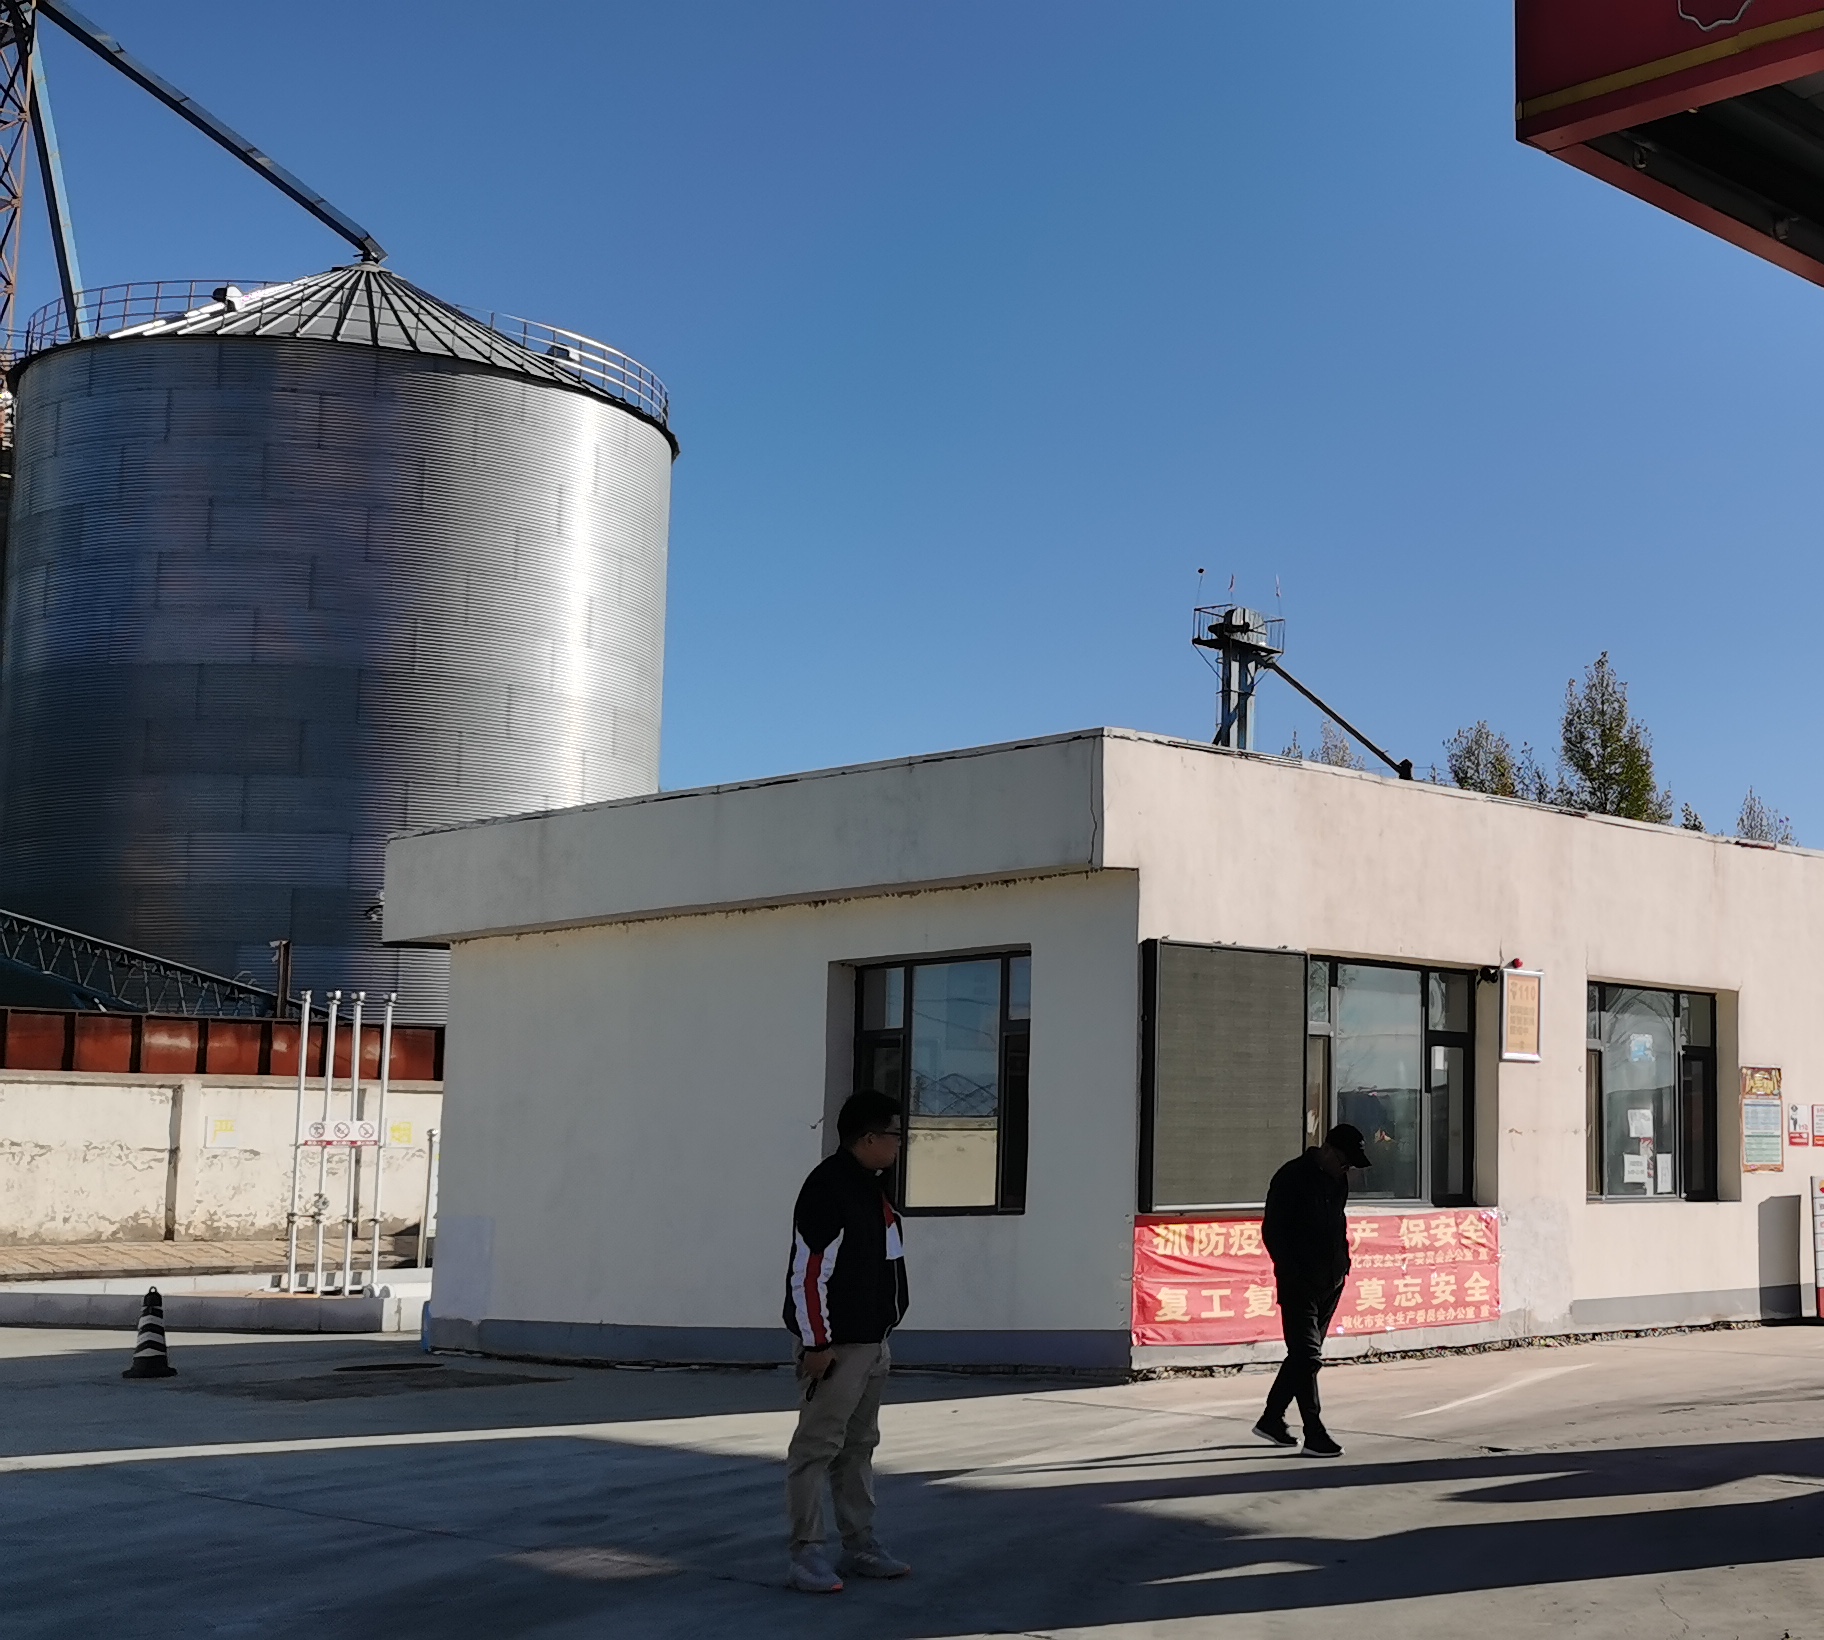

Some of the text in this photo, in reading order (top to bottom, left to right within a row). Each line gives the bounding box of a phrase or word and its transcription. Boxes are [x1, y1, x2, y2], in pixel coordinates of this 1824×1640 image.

[1152, 1214, 1487, 1257] 抓防疫 产 保安全
[1154, 1270, 1491, 1322] 复工复 莫忘安全
